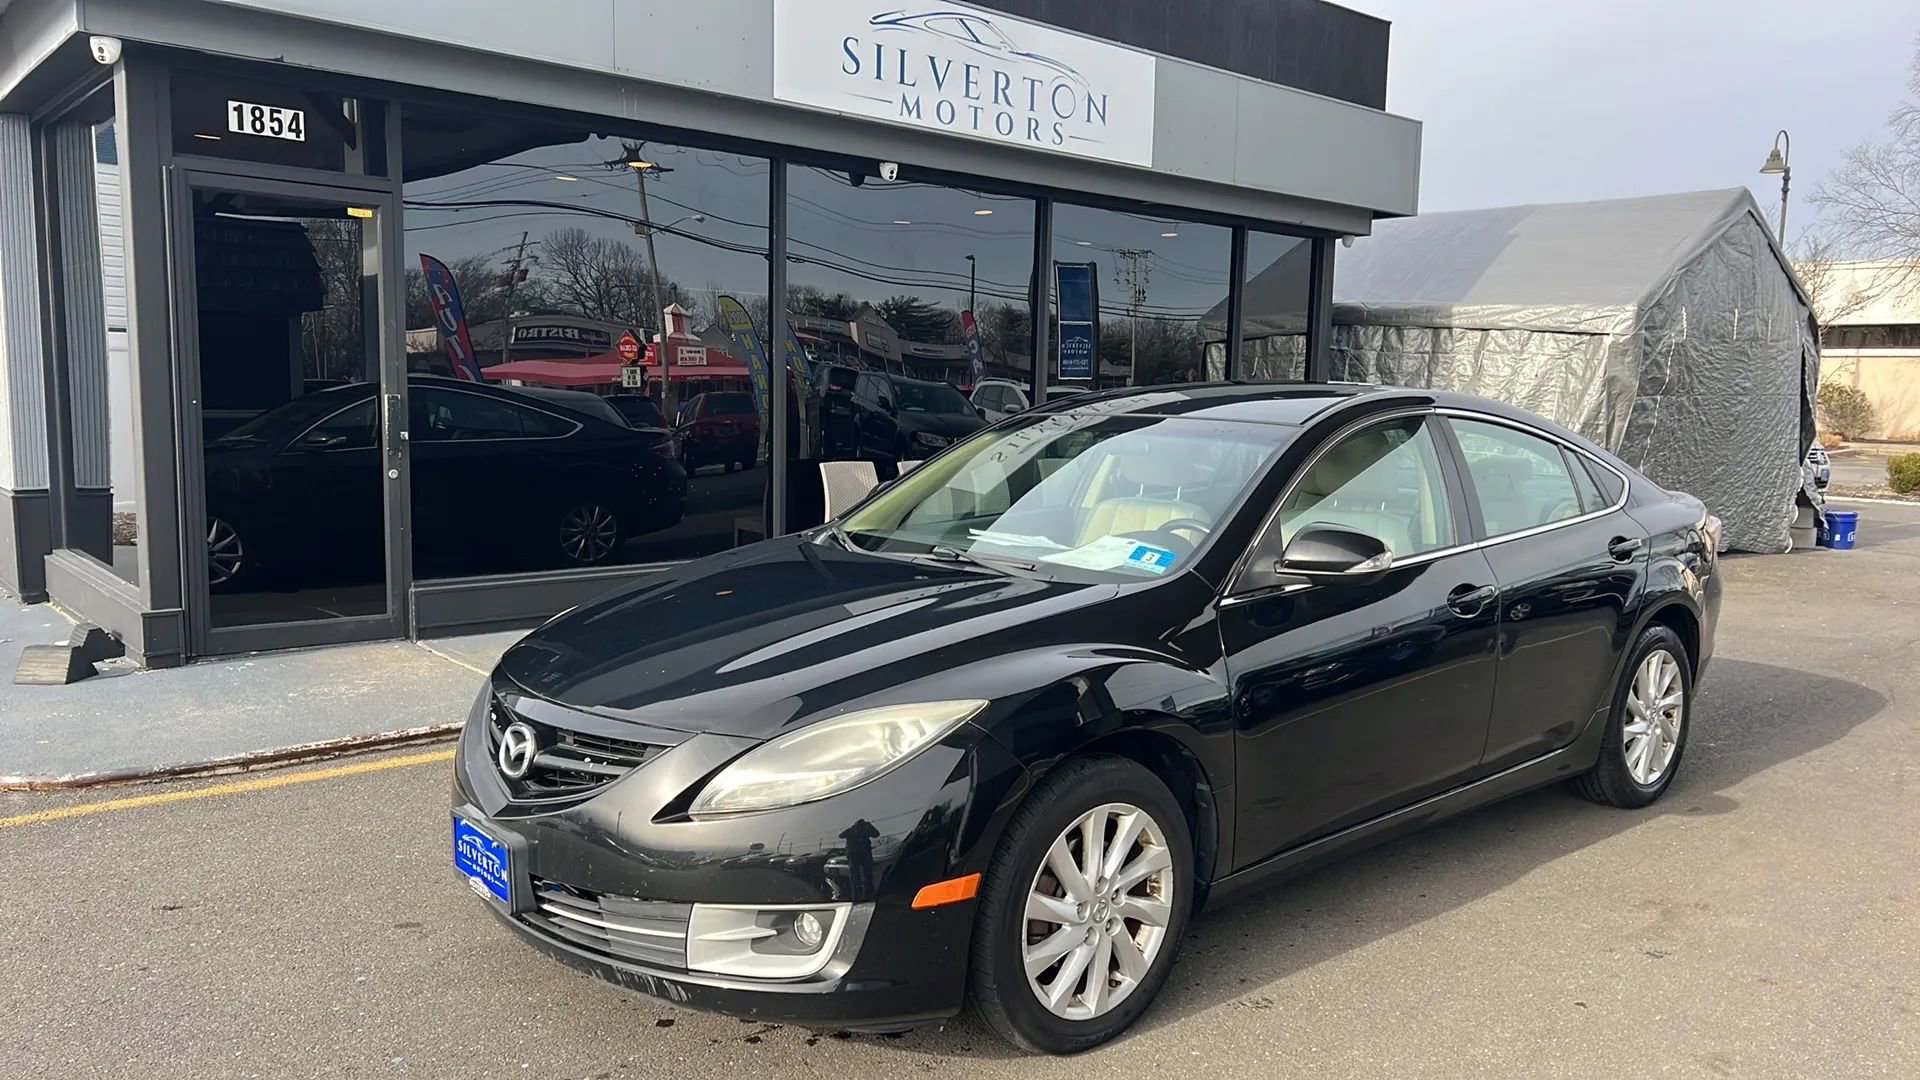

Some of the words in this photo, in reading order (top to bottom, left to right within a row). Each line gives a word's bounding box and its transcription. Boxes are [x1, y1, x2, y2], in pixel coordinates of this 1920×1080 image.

[842, 36, 1109, 127] SILVERTON
[233, 104, 303, 138] 1854
[900, 93, 1064, 146] MOTORS
[458, 840, 507, 882] SILVERTON
[472, 864, 494, 882] MOTORS
